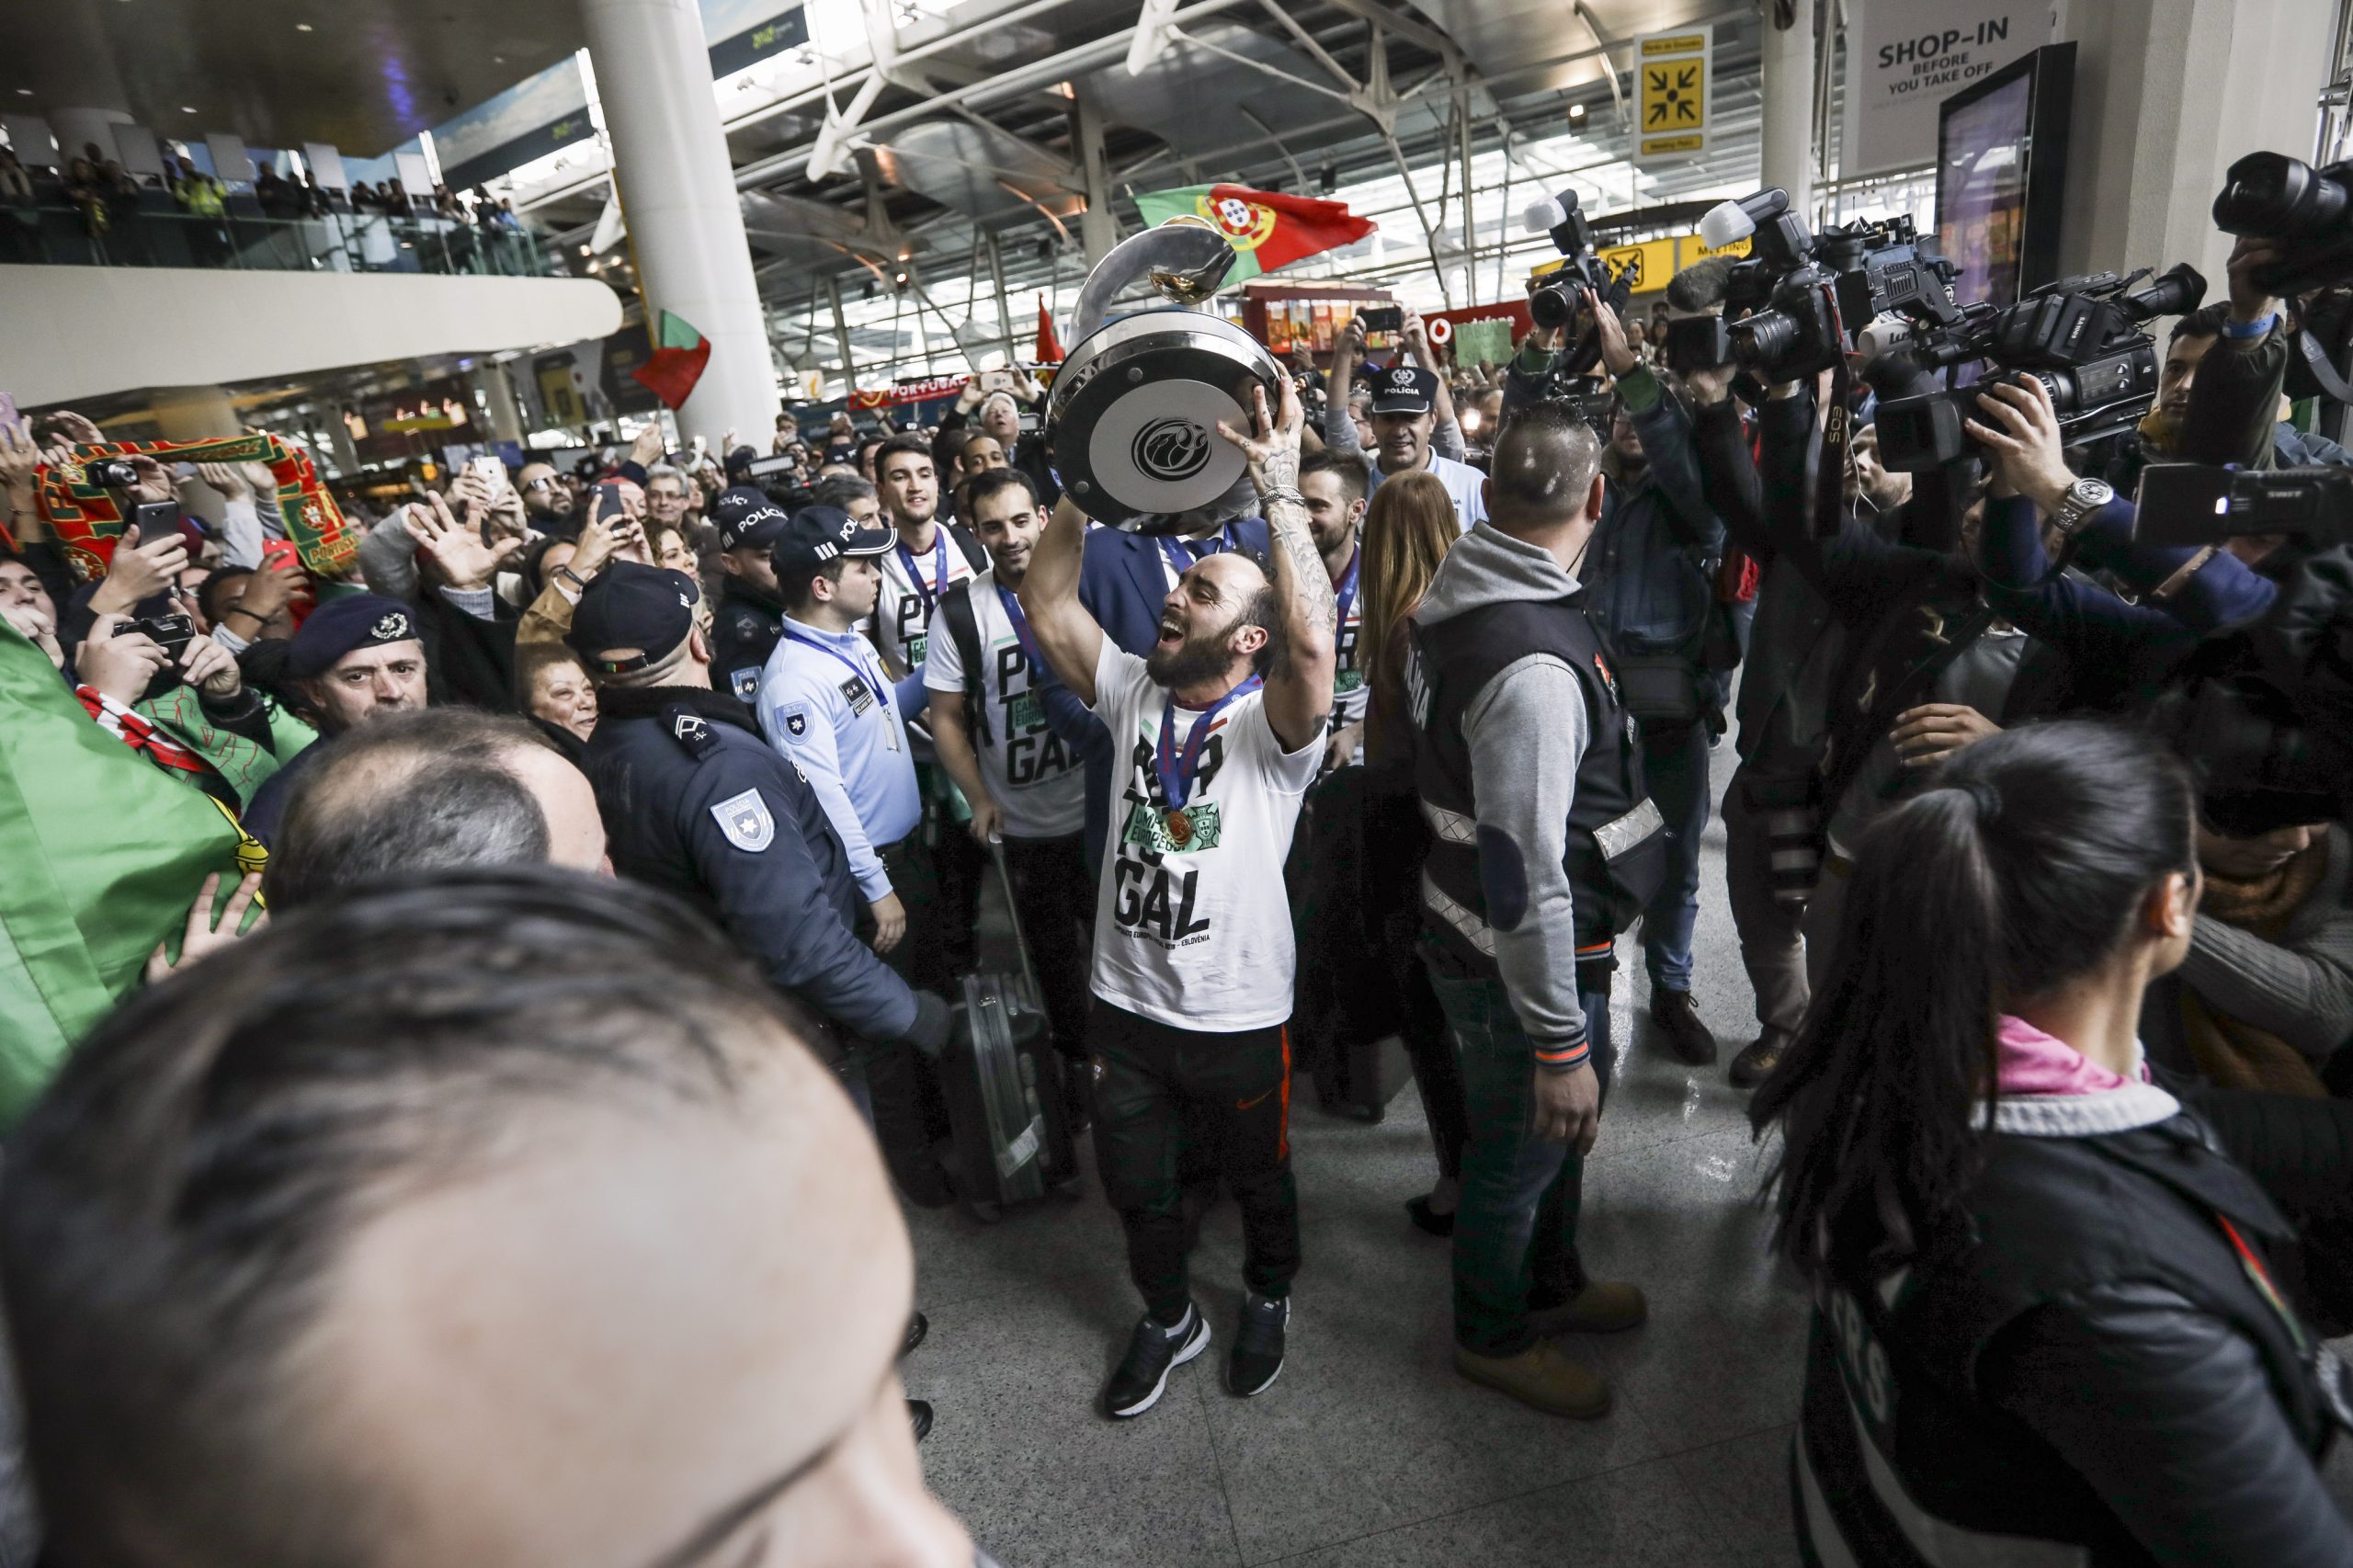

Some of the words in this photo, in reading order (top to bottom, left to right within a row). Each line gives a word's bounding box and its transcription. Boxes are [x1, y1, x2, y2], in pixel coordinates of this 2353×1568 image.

[1878, 17, 2008, 68] SHOP-IN
[1913, 51, 1970, 75] BEFORE
[1889, 79, 1919, 95] YOU
[1923, 70, 1961, 87] TAKE
[1964, 62, 1994, 78] OFF
[1892, 273, 1910, 283] SWIT
[1384, 386, 1420, 395] POLÍCIA
[1829, 405, 1843, 443] EOS
[1114, 857, 1211, 940] GAL
[1181, 934, 1211, 947] ESLOVÉNIA
